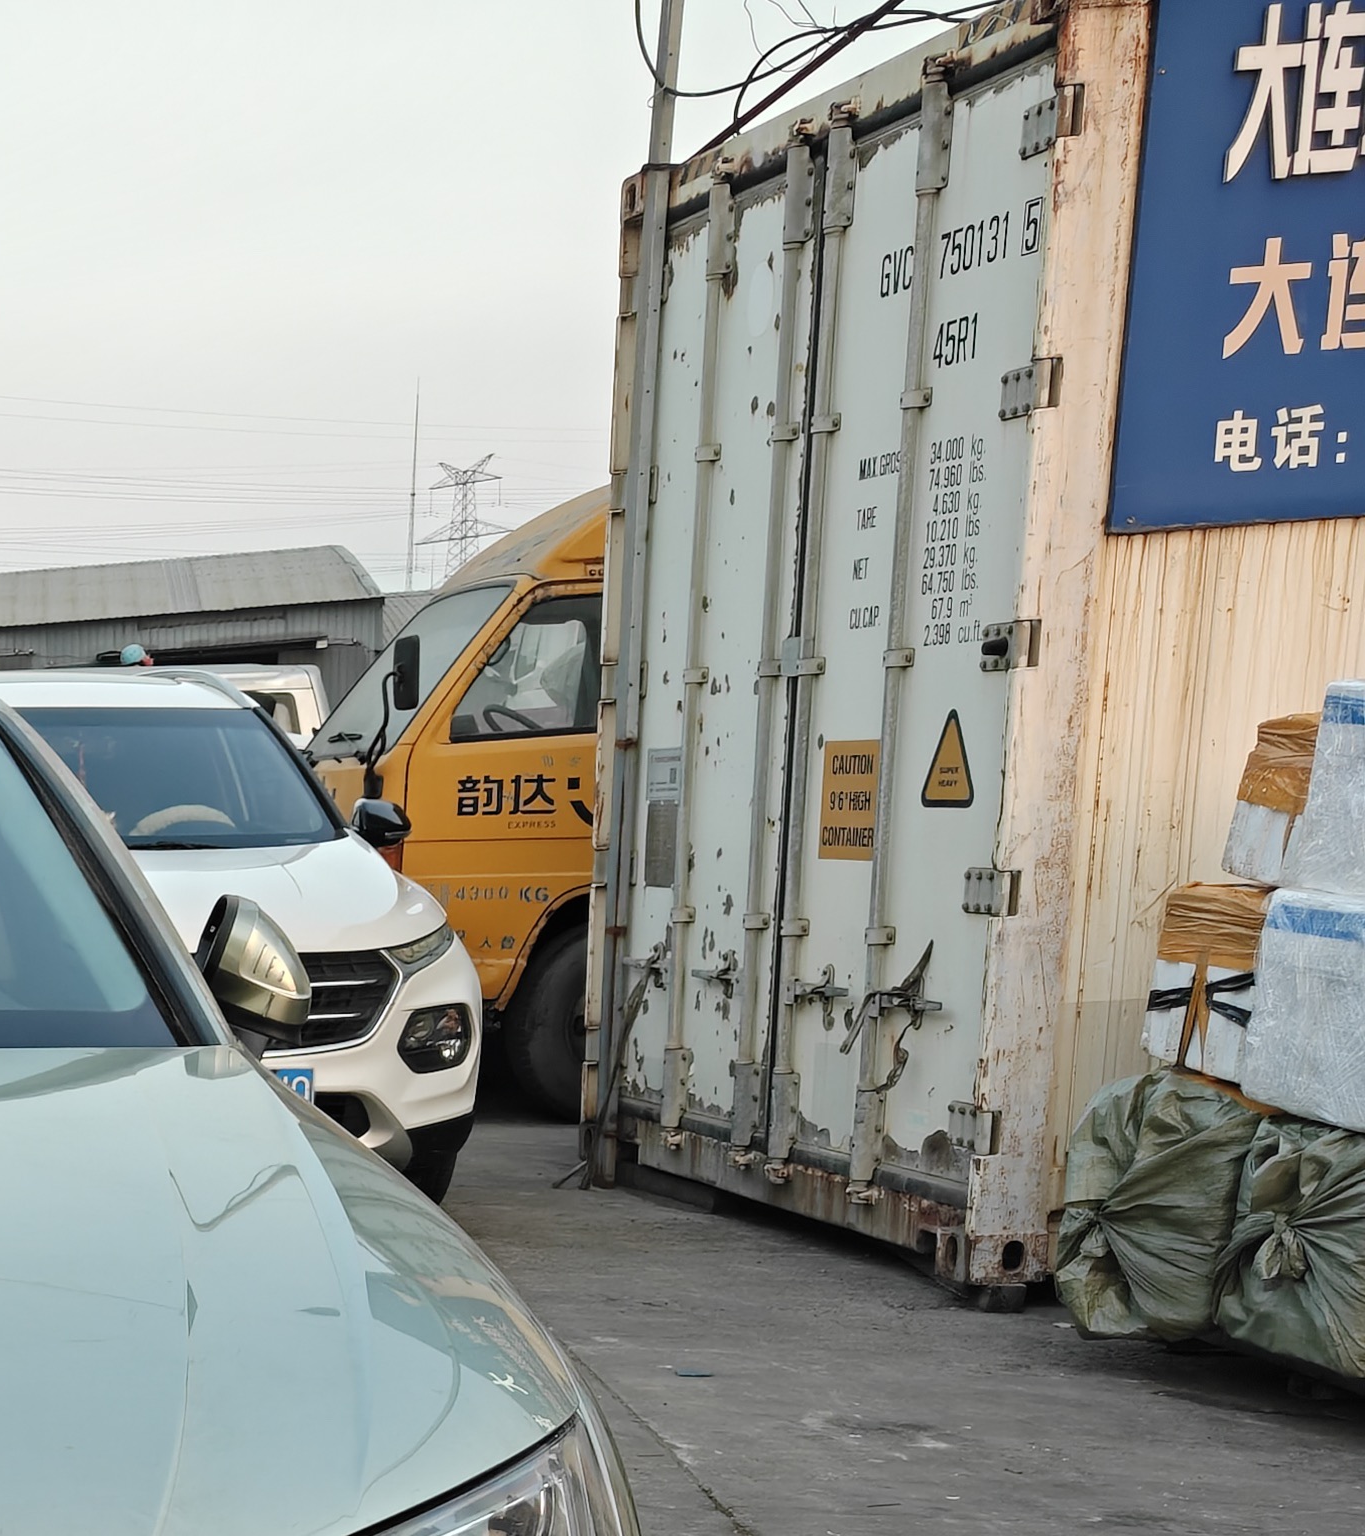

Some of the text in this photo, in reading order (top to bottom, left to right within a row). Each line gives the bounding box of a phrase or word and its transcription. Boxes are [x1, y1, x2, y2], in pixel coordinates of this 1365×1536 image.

[880, 201, 1040, 298] GVC 750131 5
[933, 313, 978, 369] 45R1
[930, 436, 964, 465] 34.000
[929, 463, 962, 491] 74.960
[933, 490, 960, 516] 4.630
[926, 517, 959, 544] 10.210
[852, 557, 869, 581] NET
[923, 543, 956, 570] 29.370
[921, 570, 955, 595] 64.750
[832, 754, 875, 776] CAUTION
[457, 774, 556, 816] 韵达
[508, 820, 556, 829] EXPRESS
[822, 827, 874, 847] CONTAINER
[520, 887, 550, 902] KG
